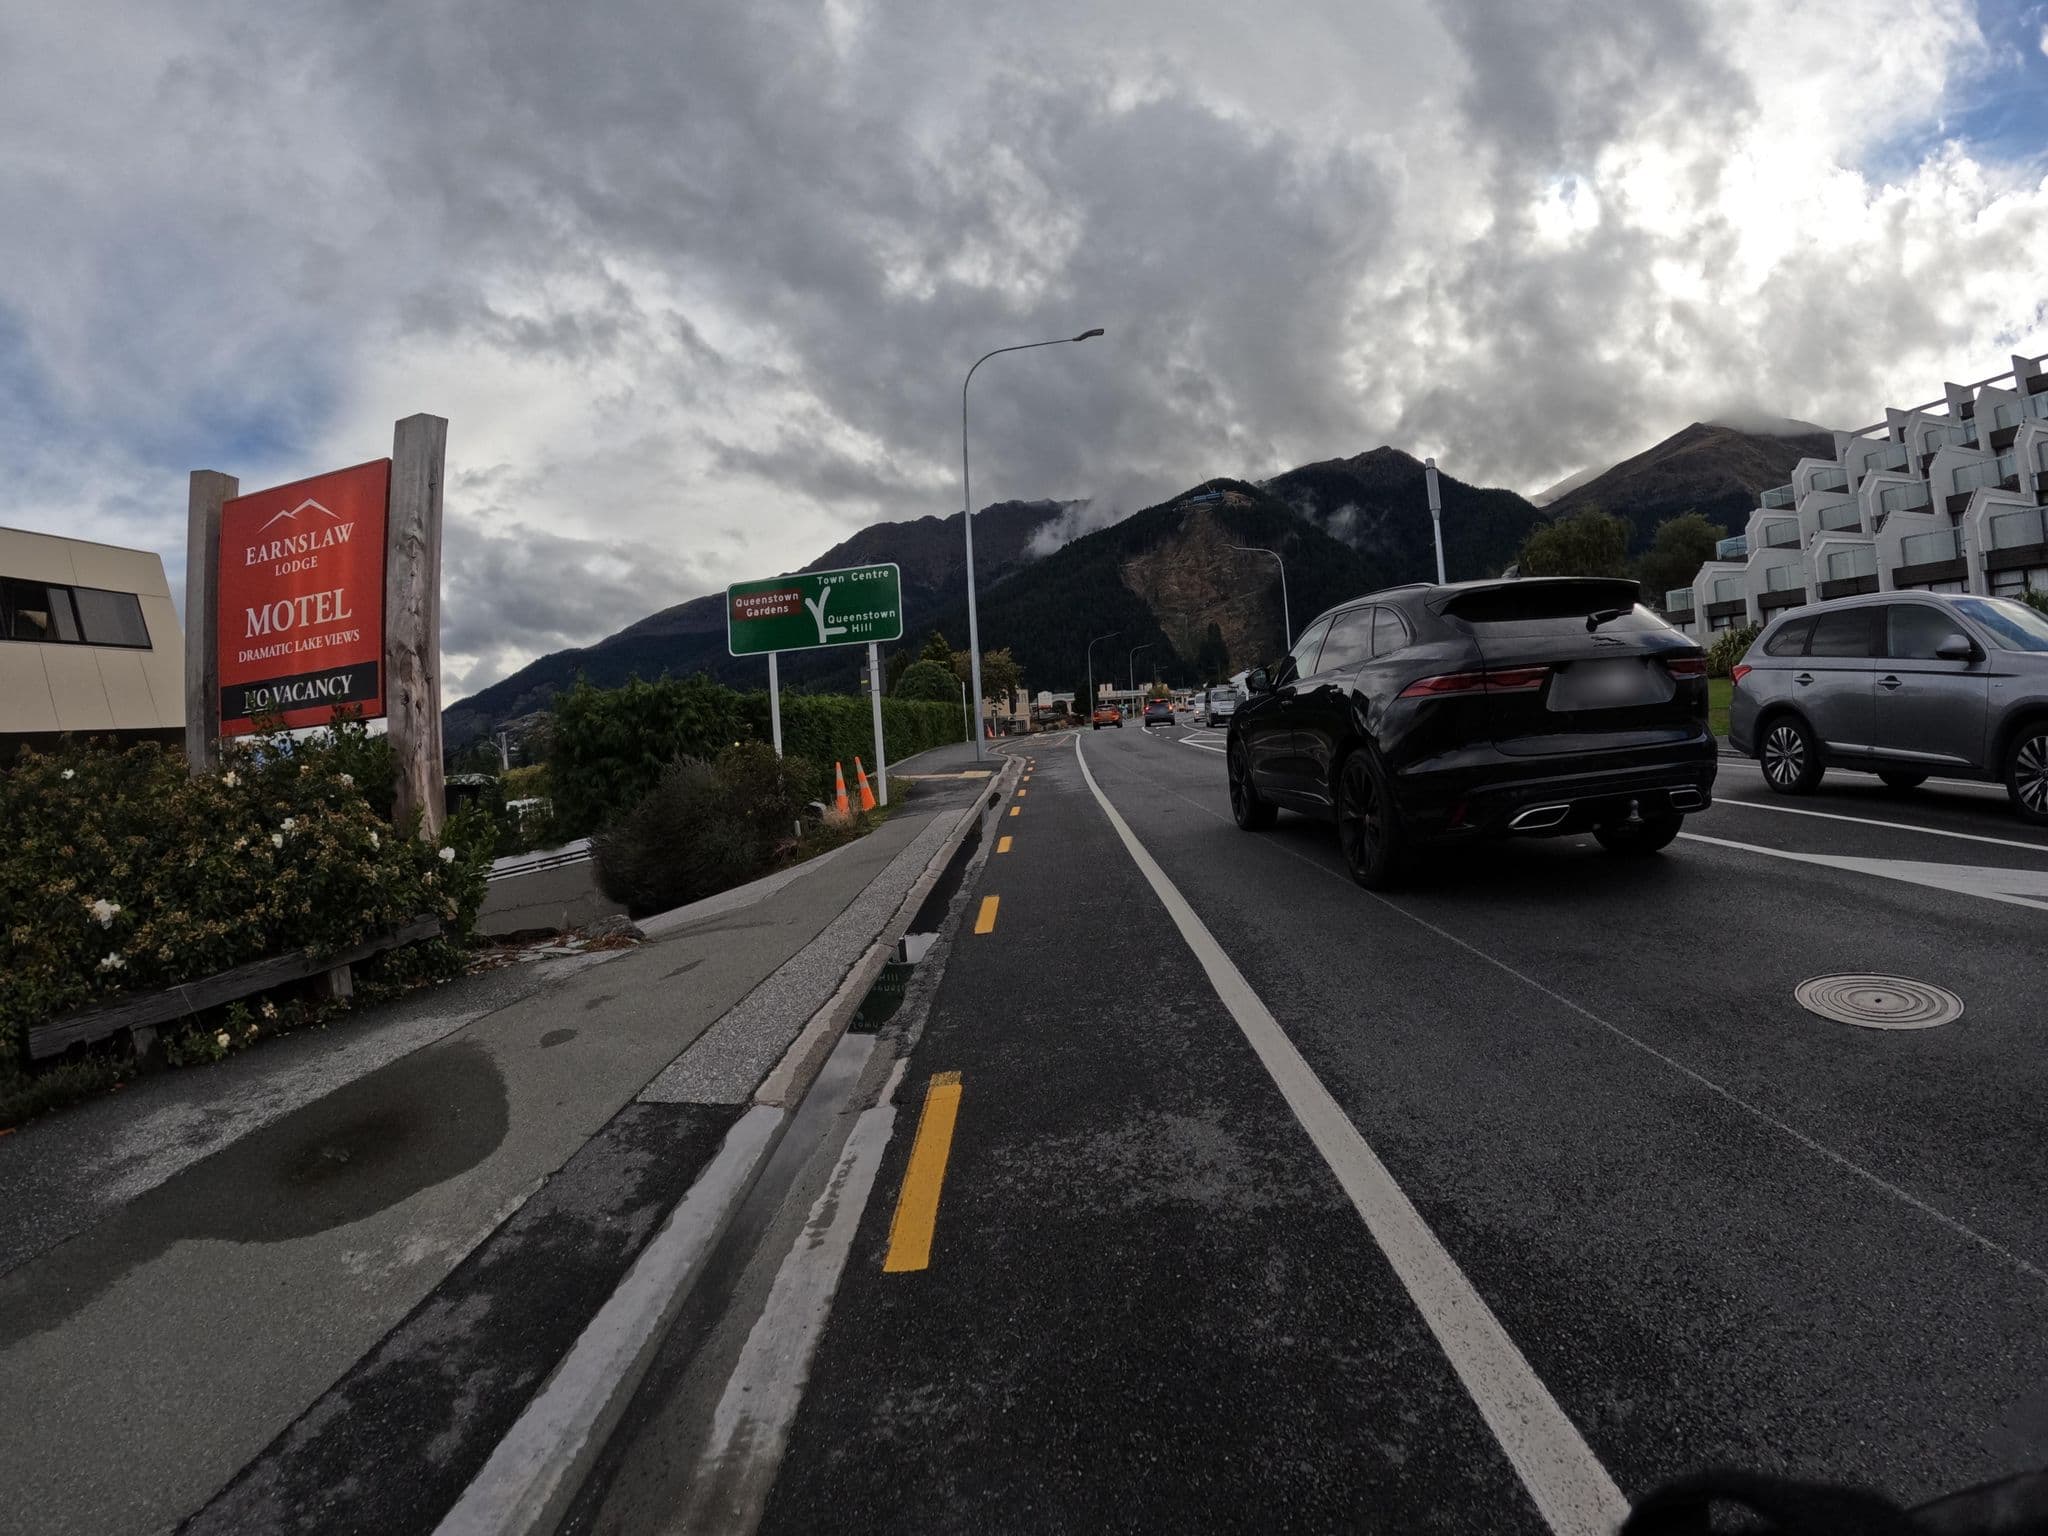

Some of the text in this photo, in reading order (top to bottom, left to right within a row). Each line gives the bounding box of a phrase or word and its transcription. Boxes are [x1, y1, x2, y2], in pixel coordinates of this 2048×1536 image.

[245, 522, 354, 566] EARNSLAW
[275, 556, 318, 576] LODGE
[817, 569, 889, 585] Town Centre
[735, 592, 799, 607] Queenstown
[245, 588, 352, 638] MOTEL
[746, 605, 789, 617] Gardens
[827, 610, 896, 624] Queenstown
[852, 623, 872, 633] Hill
[238, 629, 360, 663] DRAMATIC LAKE VIEWS
[273, 674, 353, 703] VACANCY
